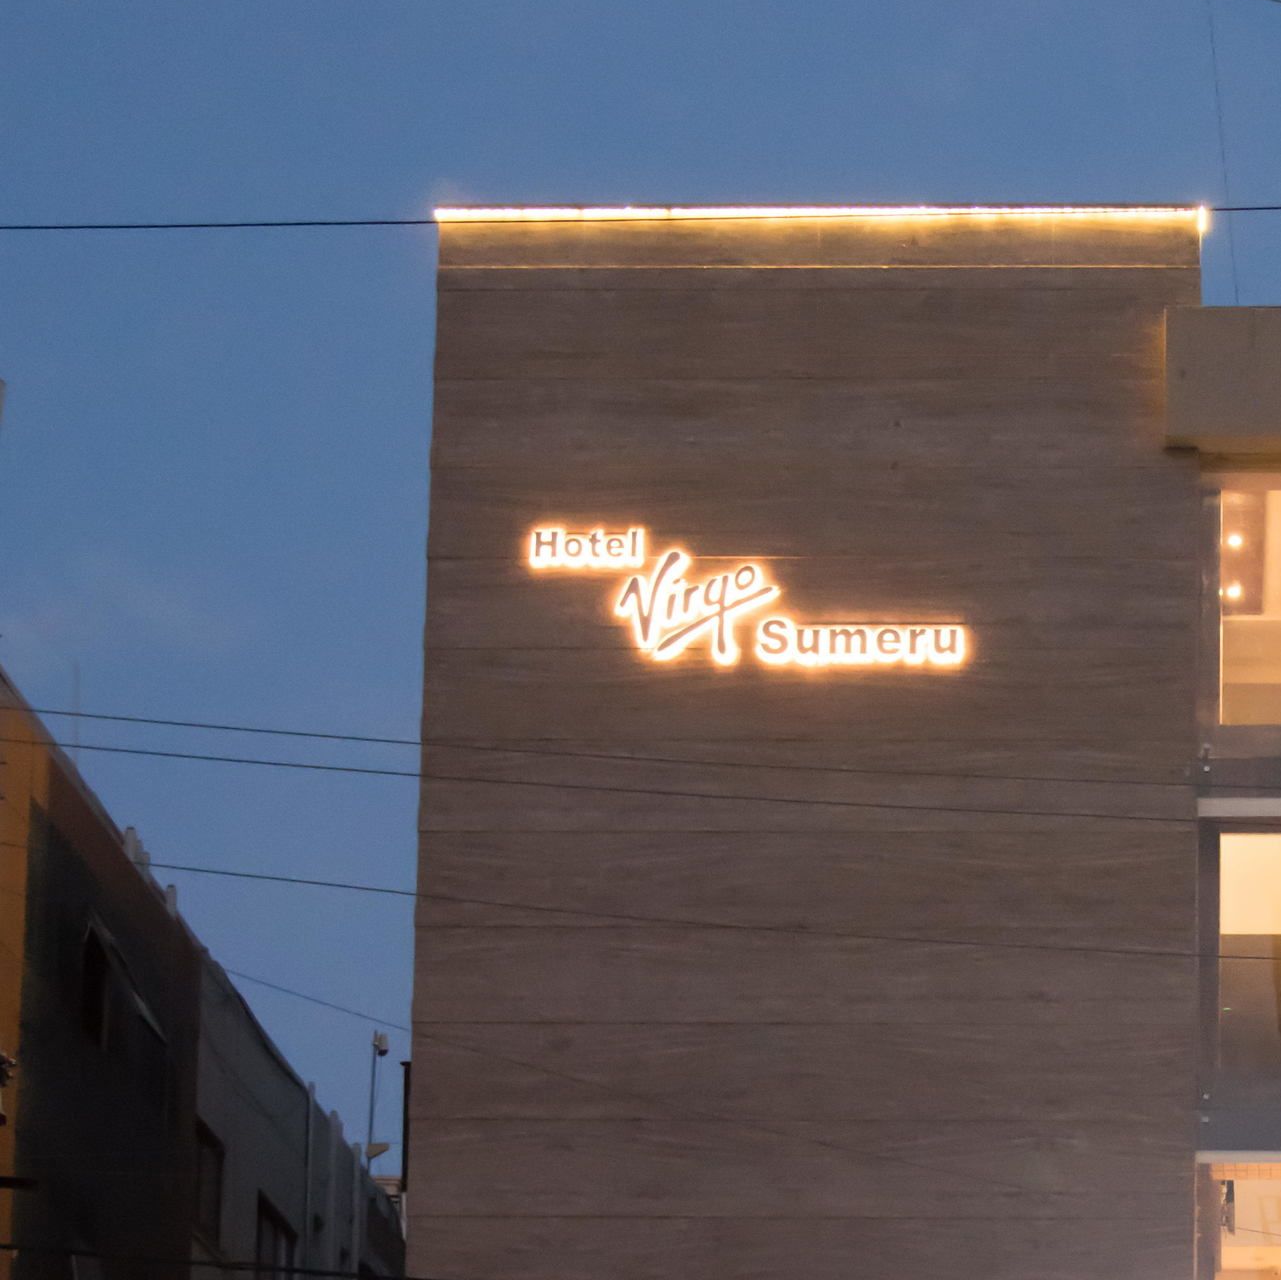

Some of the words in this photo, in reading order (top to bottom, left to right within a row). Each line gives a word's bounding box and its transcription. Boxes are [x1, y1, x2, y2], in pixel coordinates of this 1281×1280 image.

[532, 528, 641, 561] Hotel
[617, 550, 777, 656] Virgo
[759, 618, 960, 656] Sumeru
